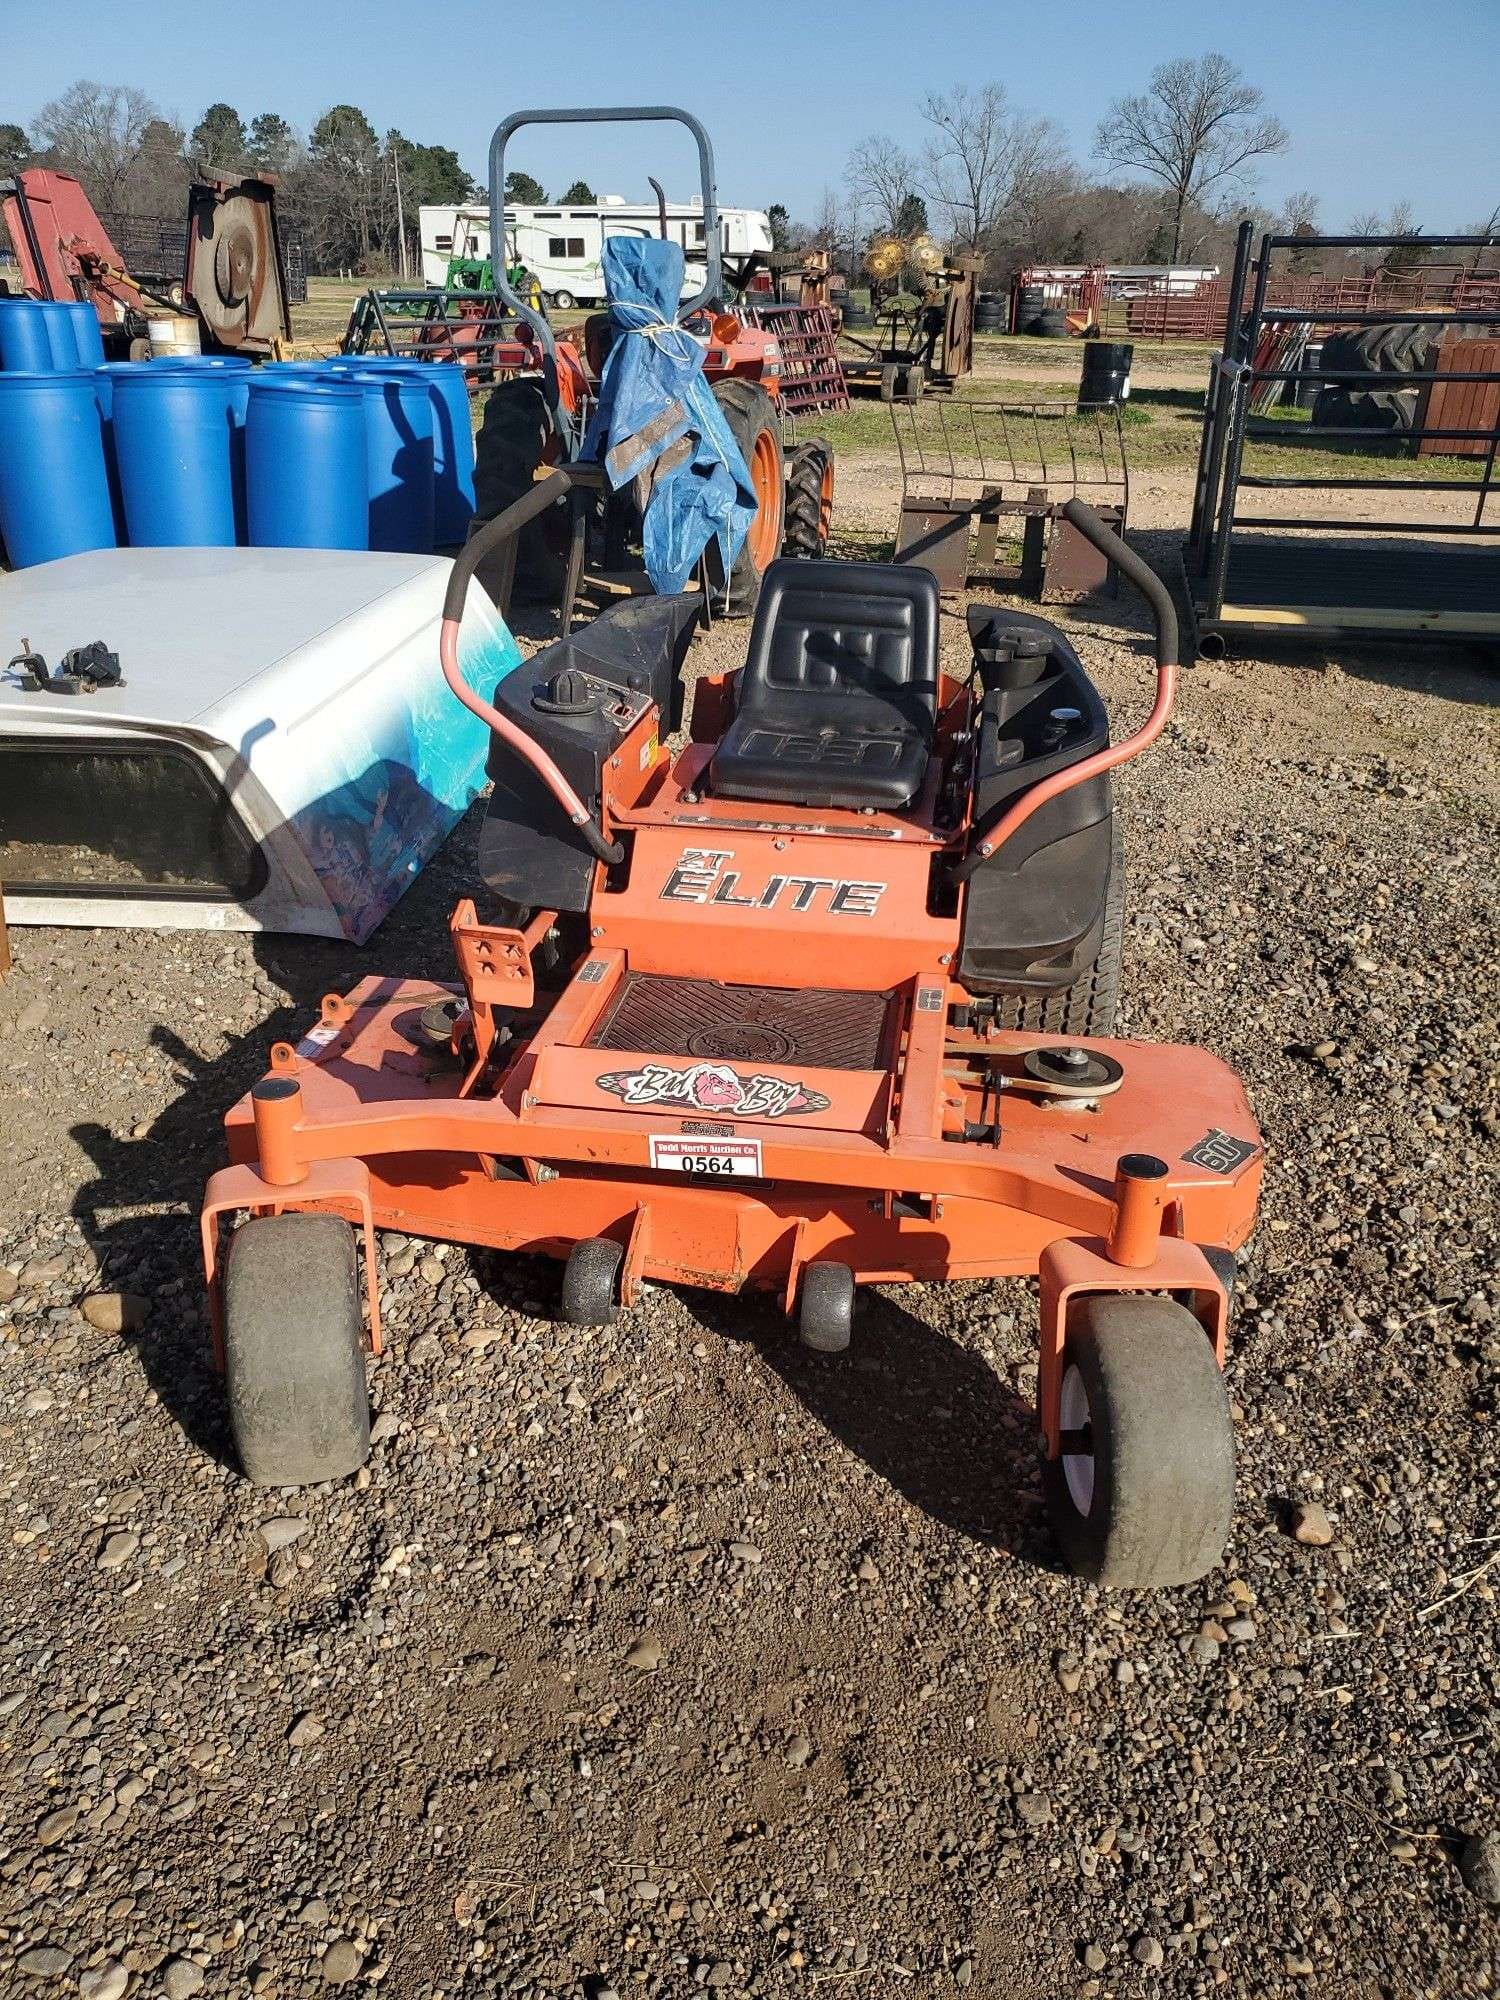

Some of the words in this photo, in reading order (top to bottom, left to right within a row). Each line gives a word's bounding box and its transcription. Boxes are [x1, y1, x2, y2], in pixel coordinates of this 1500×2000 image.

[677, 848, 735, 870] ZT
[659, 868, 888, 917] ELITE
[625, 1065, 694, 1103] Bad
[734, 1075, 803, 1117] Boy
[657, 1143, 679, 1153] Todd
[681, 1144, 708, 1154] Morris
[709, 1145, 741, 1155] Auction
[743, 1146, 757, 1155] Co.
[682, 1156, 735, 1174] 0564
